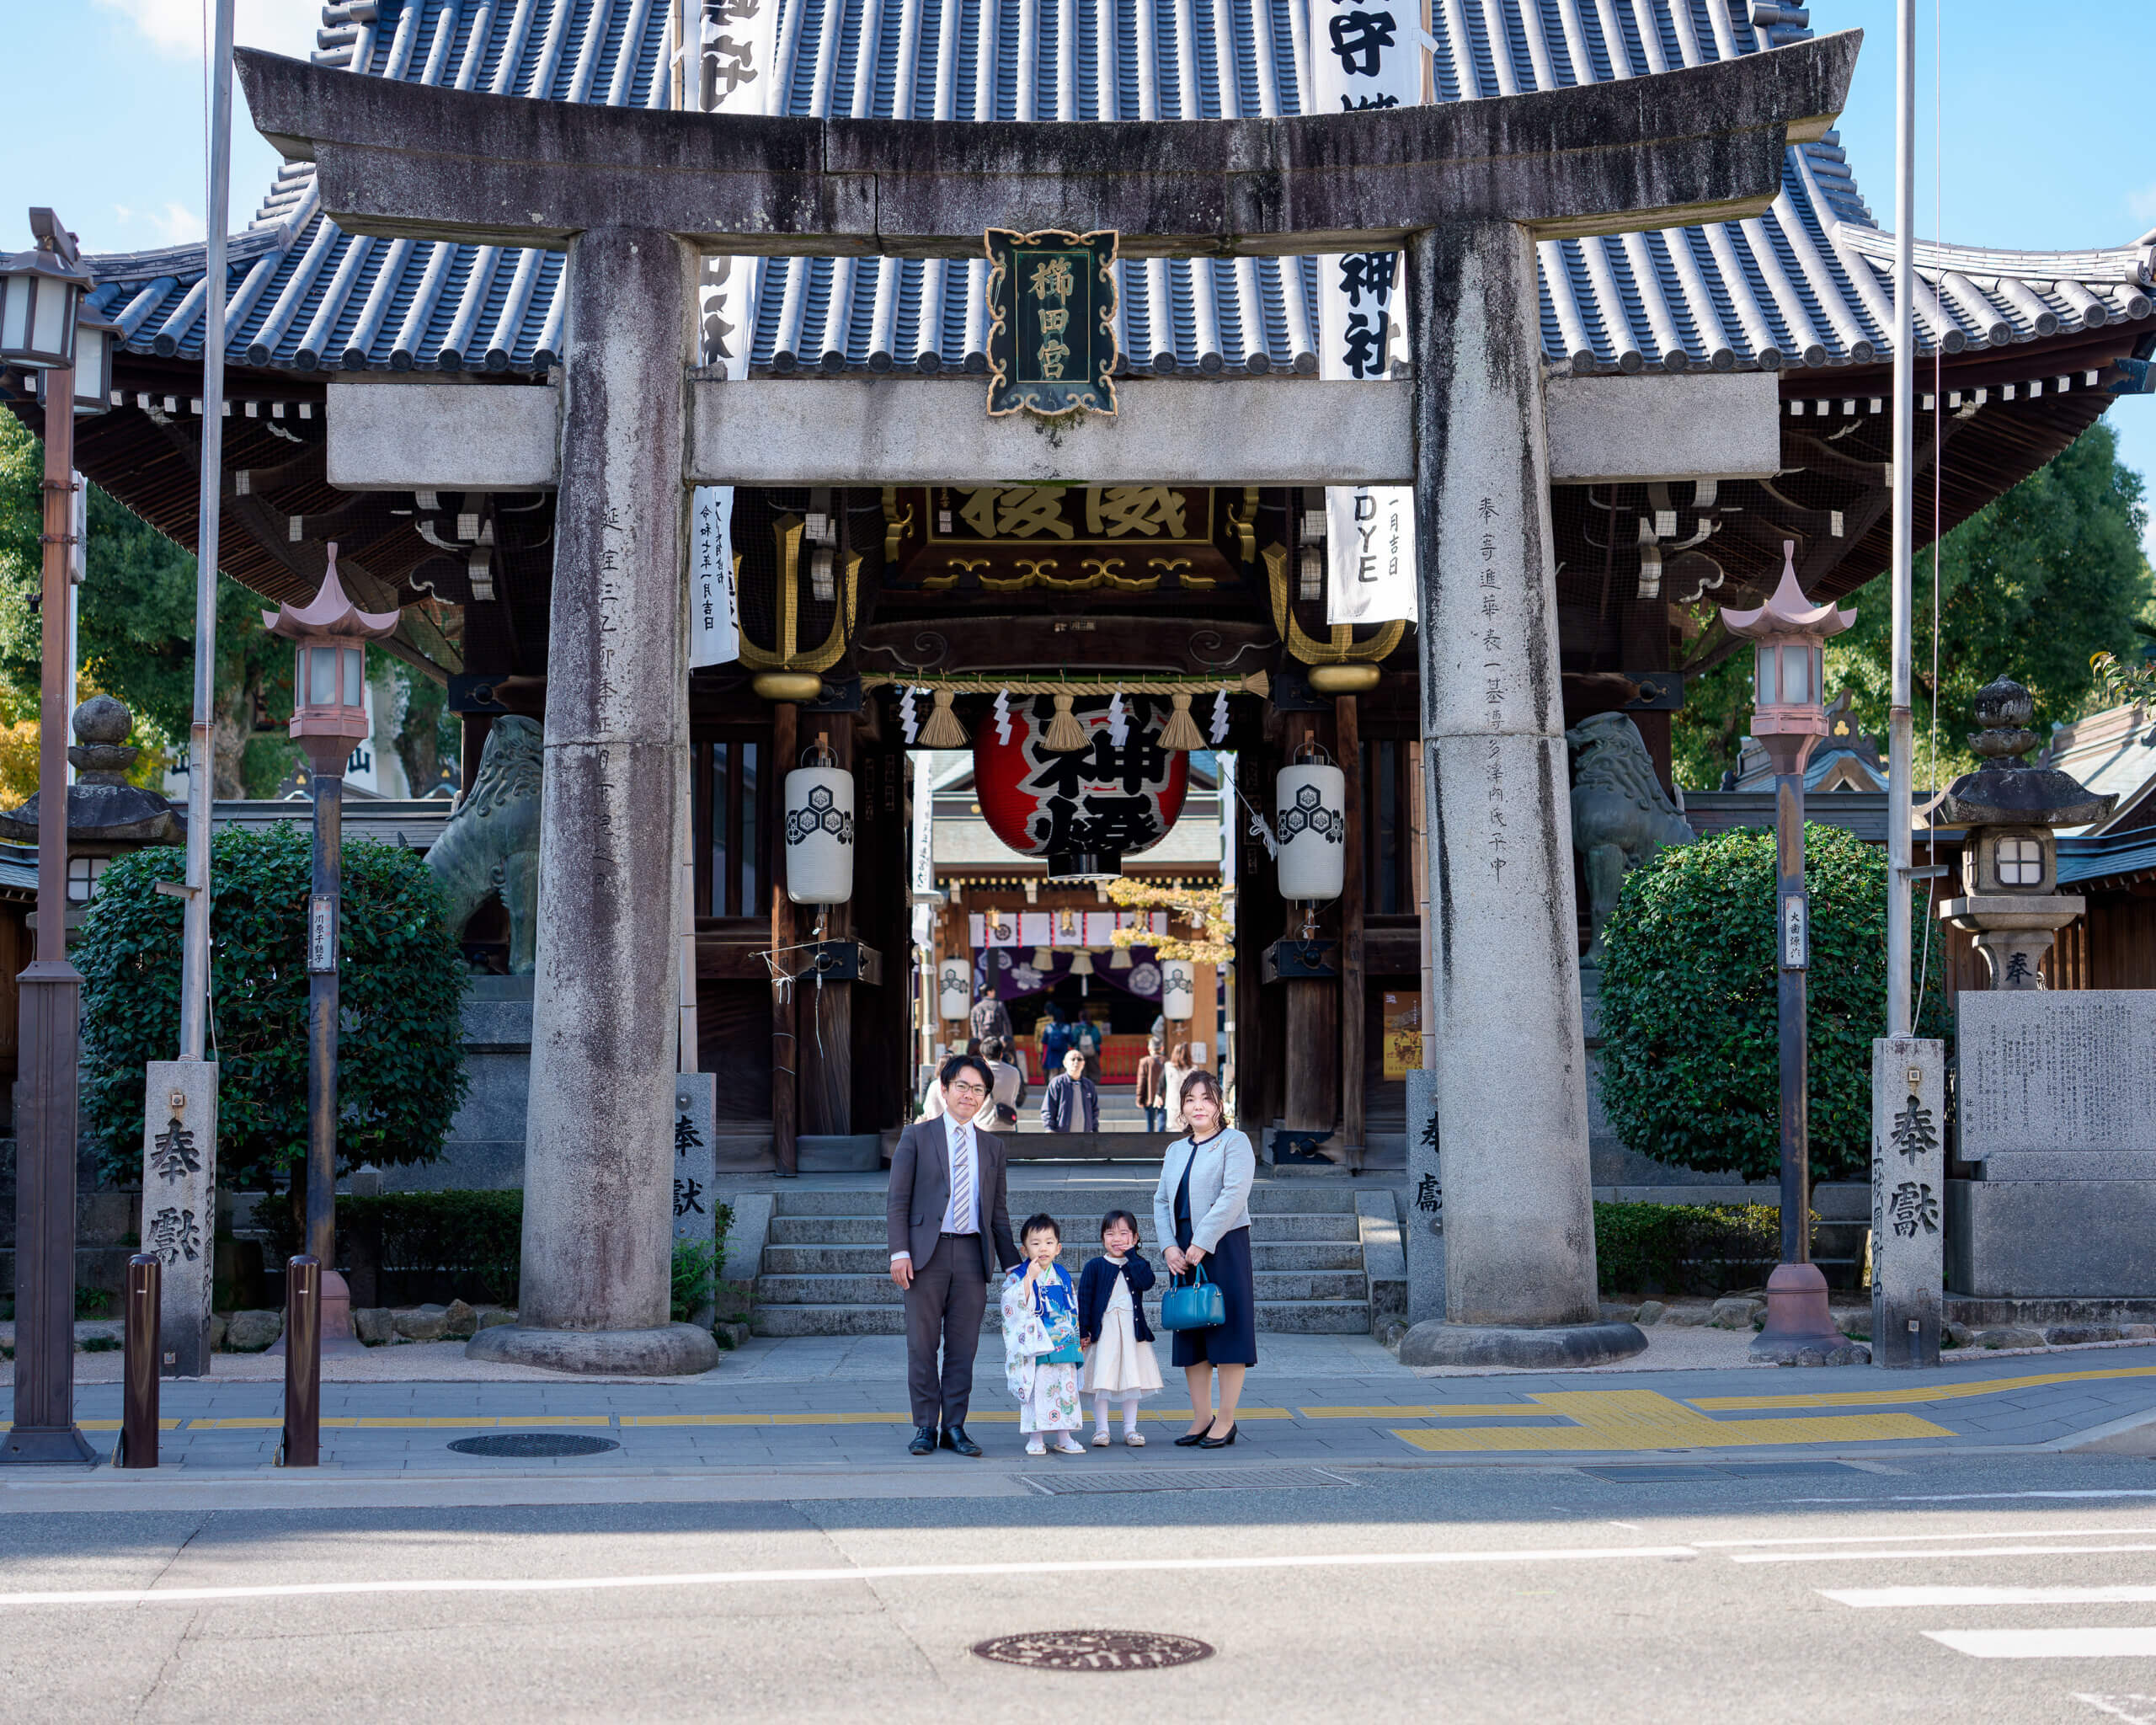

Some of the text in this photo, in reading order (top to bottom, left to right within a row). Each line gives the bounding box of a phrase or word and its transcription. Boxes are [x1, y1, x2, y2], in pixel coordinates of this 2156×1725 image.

[1028, 256, 1074, 379] 櫛田宮
[2005, 952, 2032, 985] 奉
